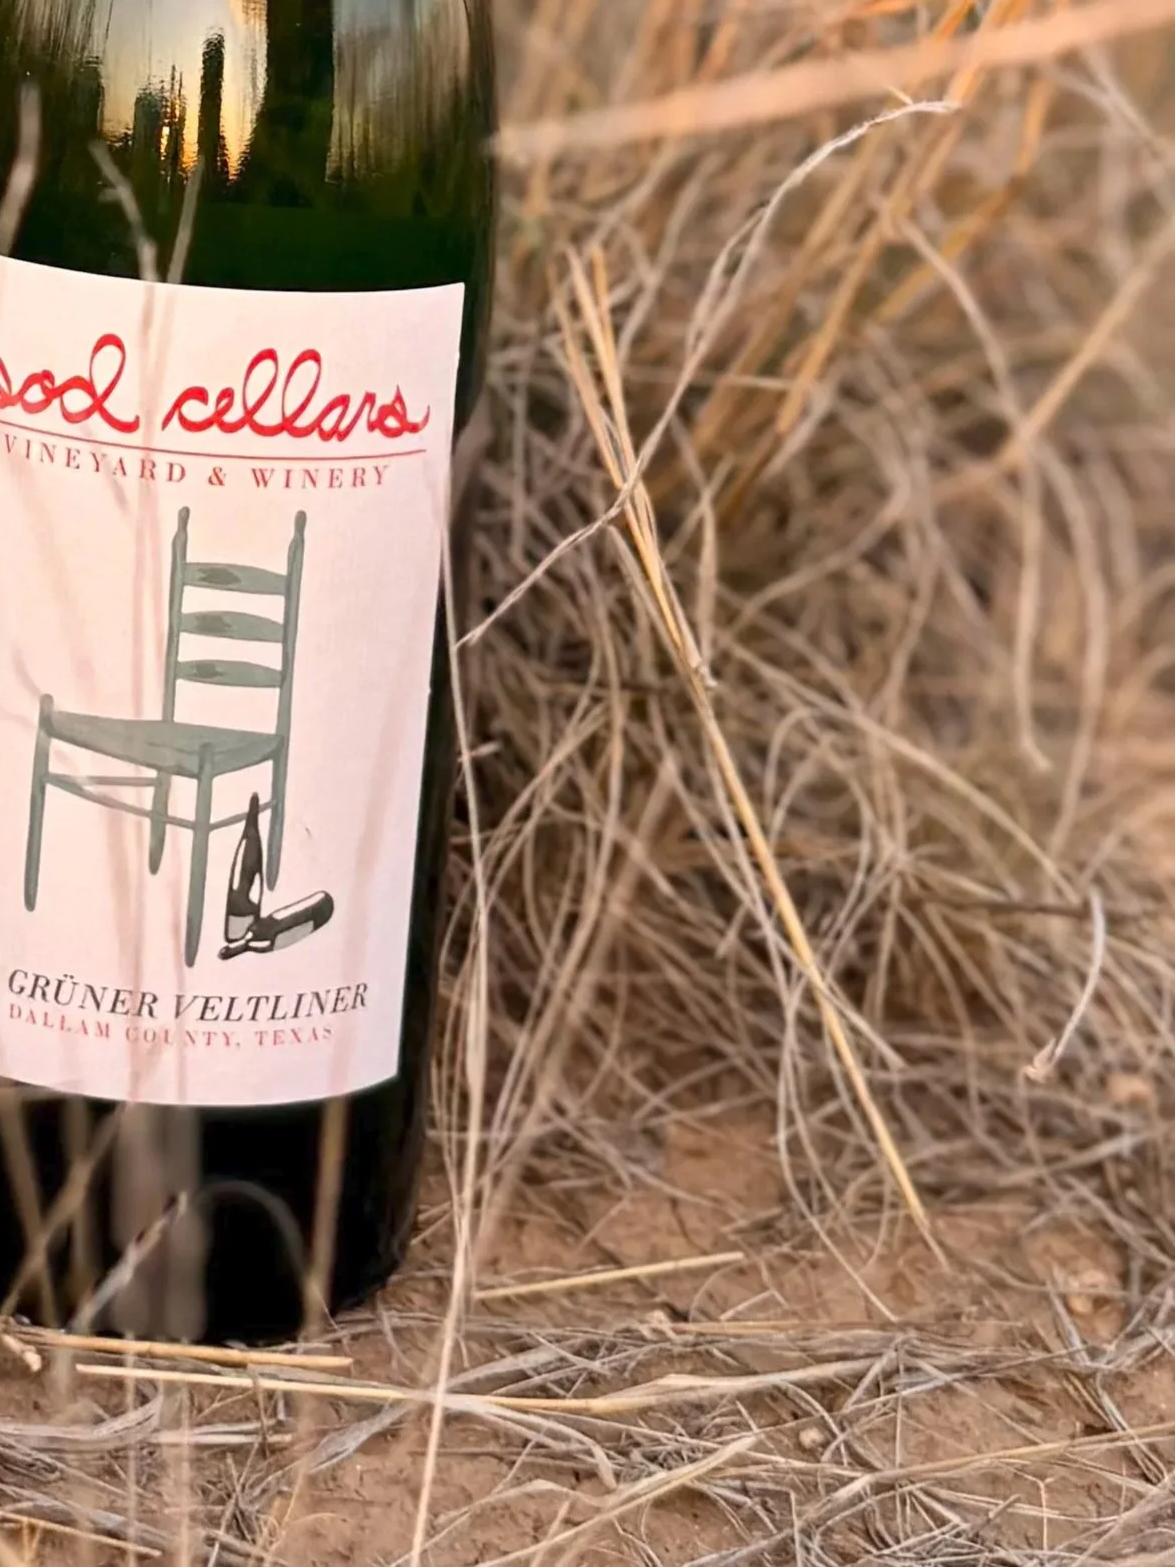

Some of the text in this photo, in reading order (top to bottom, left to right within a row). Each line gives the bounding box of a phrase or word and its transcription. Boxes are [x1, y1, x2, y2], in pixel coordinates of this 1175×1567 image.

[161, 348, 431, 442] cellars
[4, 433, 390, 489] VINEYARD & WINERY
[8, 968, 369, 1023] GRÜNER VELTLINER
[9, 1003, 334, 1049] DALLAM COUNTY, TEXAS
